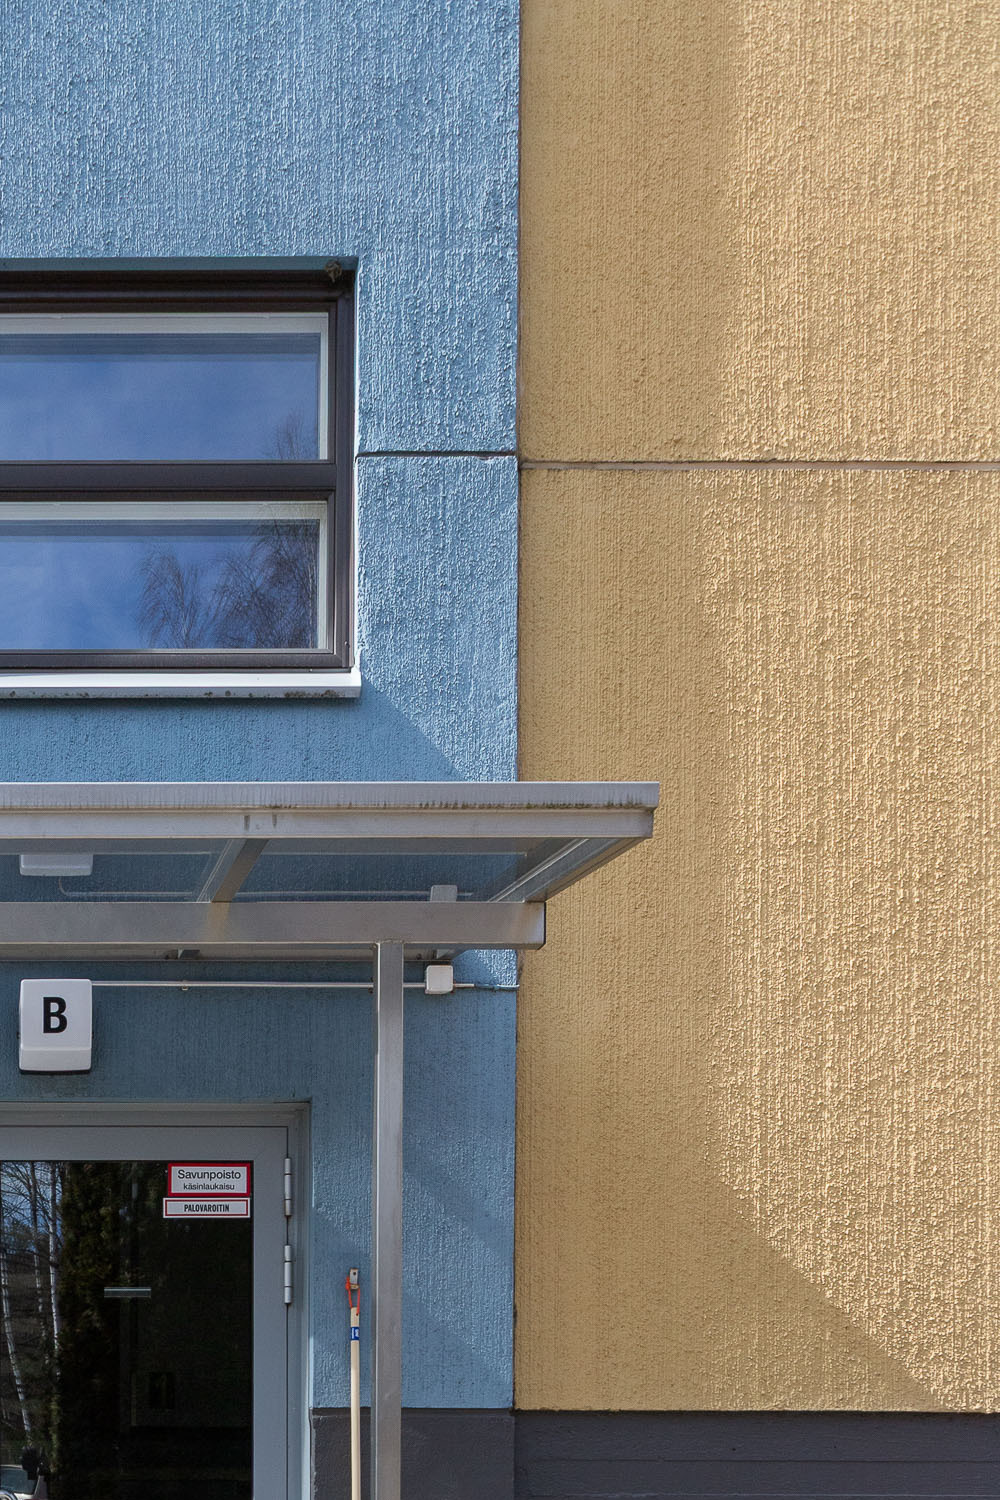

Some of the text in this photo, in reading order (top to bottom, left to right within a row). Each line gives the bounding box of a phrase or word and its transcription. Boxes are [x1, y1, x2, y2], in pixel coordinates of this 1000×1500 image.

[43, 997, 67, 1033] B
[178, 1169, 241, 1181] Savunpoisto
[184, 1204, 229, 1212] PALOVAROITIN
